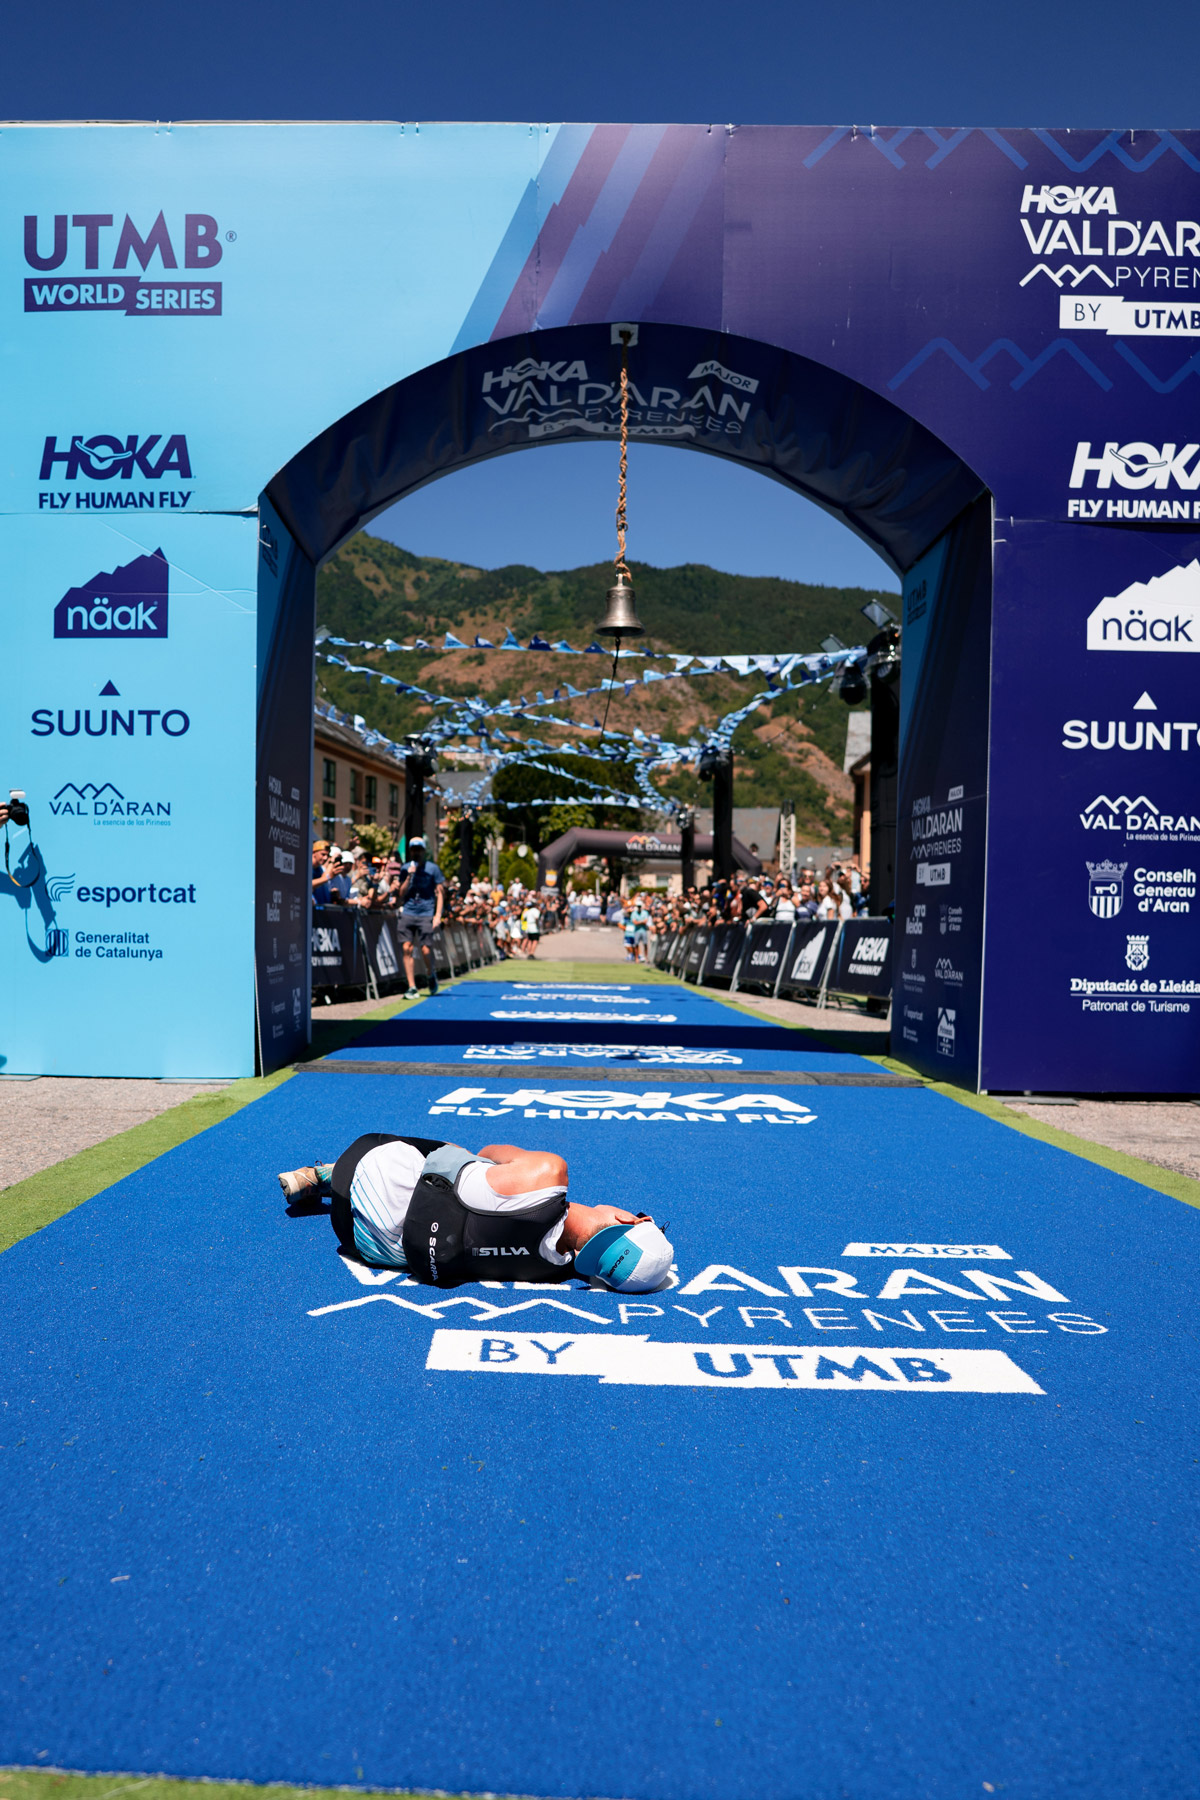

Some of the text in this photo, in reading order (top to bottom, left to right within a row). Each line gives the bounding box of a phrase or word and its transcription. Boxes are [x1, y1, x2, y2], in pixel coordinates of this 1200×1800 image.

[1020, 185, 1118, 215] HOKA
[31, 283, 217, 311] WORLD SERIES
[1073, 303, 1200, 330] BY UTMB
[481, 357, 589, 393] HOKA
[700, 363, 752, 390] MAJOR
[38, 434, 194, 481] HOKA
[1068, 441, 1200, 490] HOK
[38, 491, 192, 509] FLY HUMAN FLY
[1067, 499, 1104, 518] FLY
[1106, 499, 1190, 519] HUMAN
[66, 597, 159, 631] näak
[1102, 609, 1194, 643] näak
[30, 709, 191, 738] SUUNTO
[1061, 719, 1200, 751] SUUNT
[49, 799, 172, 817] VAL D'ARAN
[93, 818, 171, 827] La esencia de los Pirineos
[1079, 812, 1200, 832] VAL D'ARAN
[1126, 831, 1134, 841] La
[1133, 867, 1197, 884] Conselh
[76, 883, 197, 908] esportcat
[1133, 883, 1197, 898] Generau
[1138, 898, 1190, 913] d'Aran
[75, 931, 150, 945] Generalitat
[75, 946, 163, 962] de Catalunya
[750, 951, 780, 968] SUUNTO
[852, 936, 890, 963] HOKA
[1070, 978, 1139, 995] Diputació
[1139, 979, 1158, 993] de
[1082, 999, 1191, 1013] Patronat de Turisme
[434, 1087, 812, 1113] HOKA
[427, 1106, 819, 1125] FLY HUMAN FLY
[428, 1236, 439, 1281] SCARPA
[479, 1246, 531, 1256] SILVA
[869, 1244, 992, 1257] MAJOR
[617, 1302, 1110, 1336] PYRENEES
[478, 1338, 954, 1384] BY UTMB
